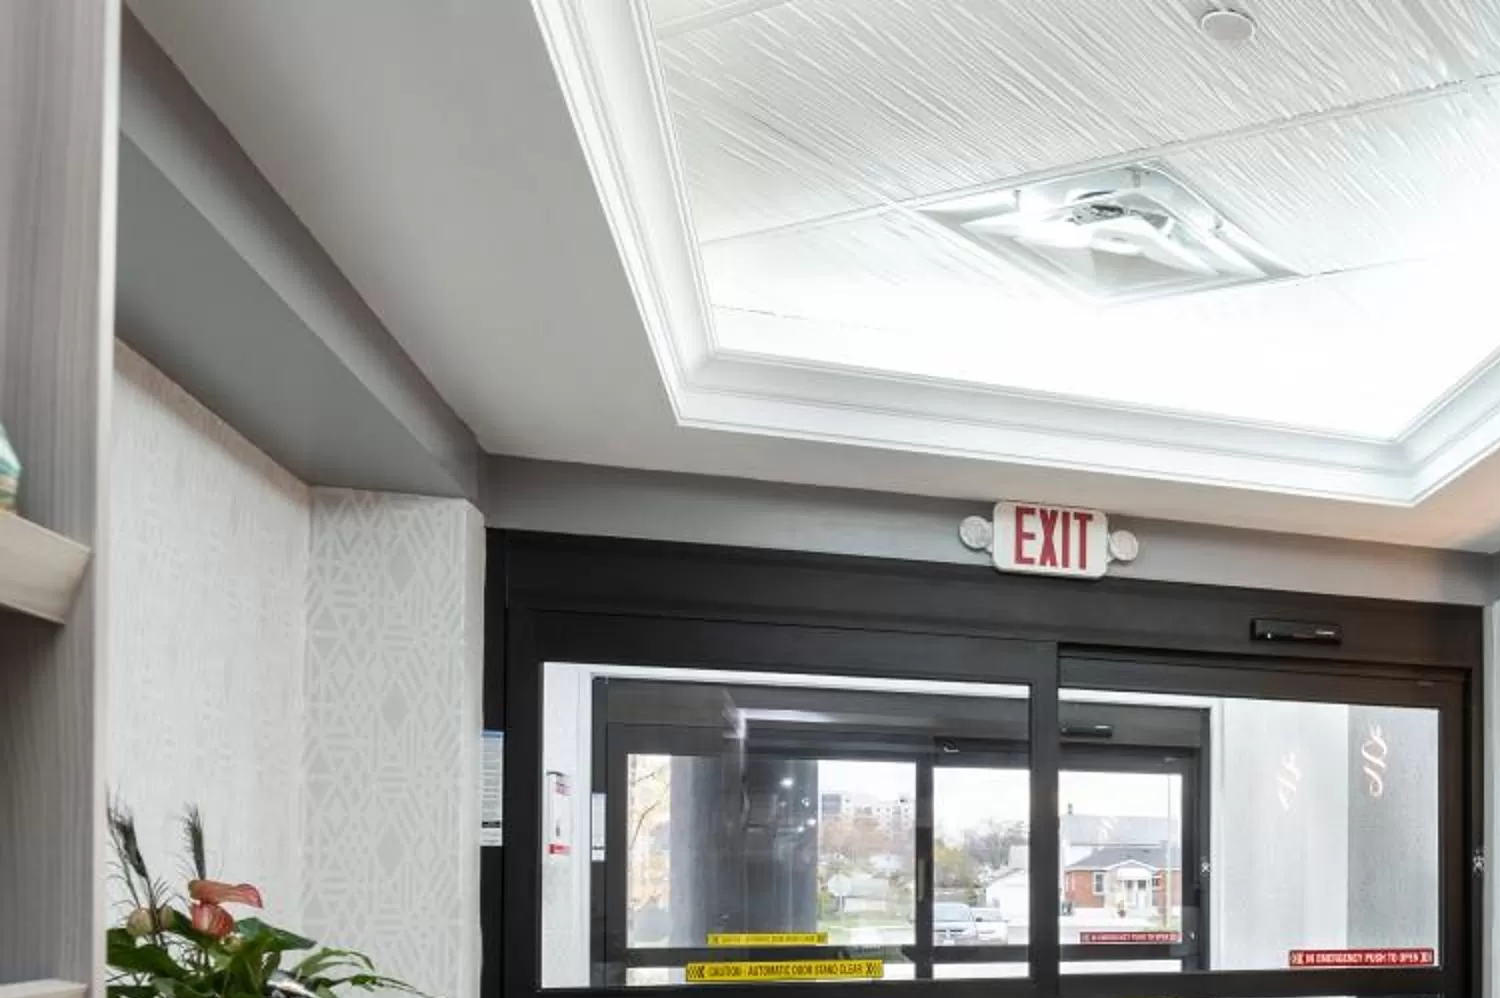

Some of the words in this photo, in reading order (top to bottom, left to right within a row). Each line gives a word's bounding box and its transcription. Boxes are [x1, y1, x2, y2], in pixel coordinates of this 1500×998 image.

[1014, 505, 1094, 570] EXIT
[747, 964, 790, 976] AUTOMATIC
[815, 963, 838, 975] STAND
[839, 963, 862, 975] CLEAR
